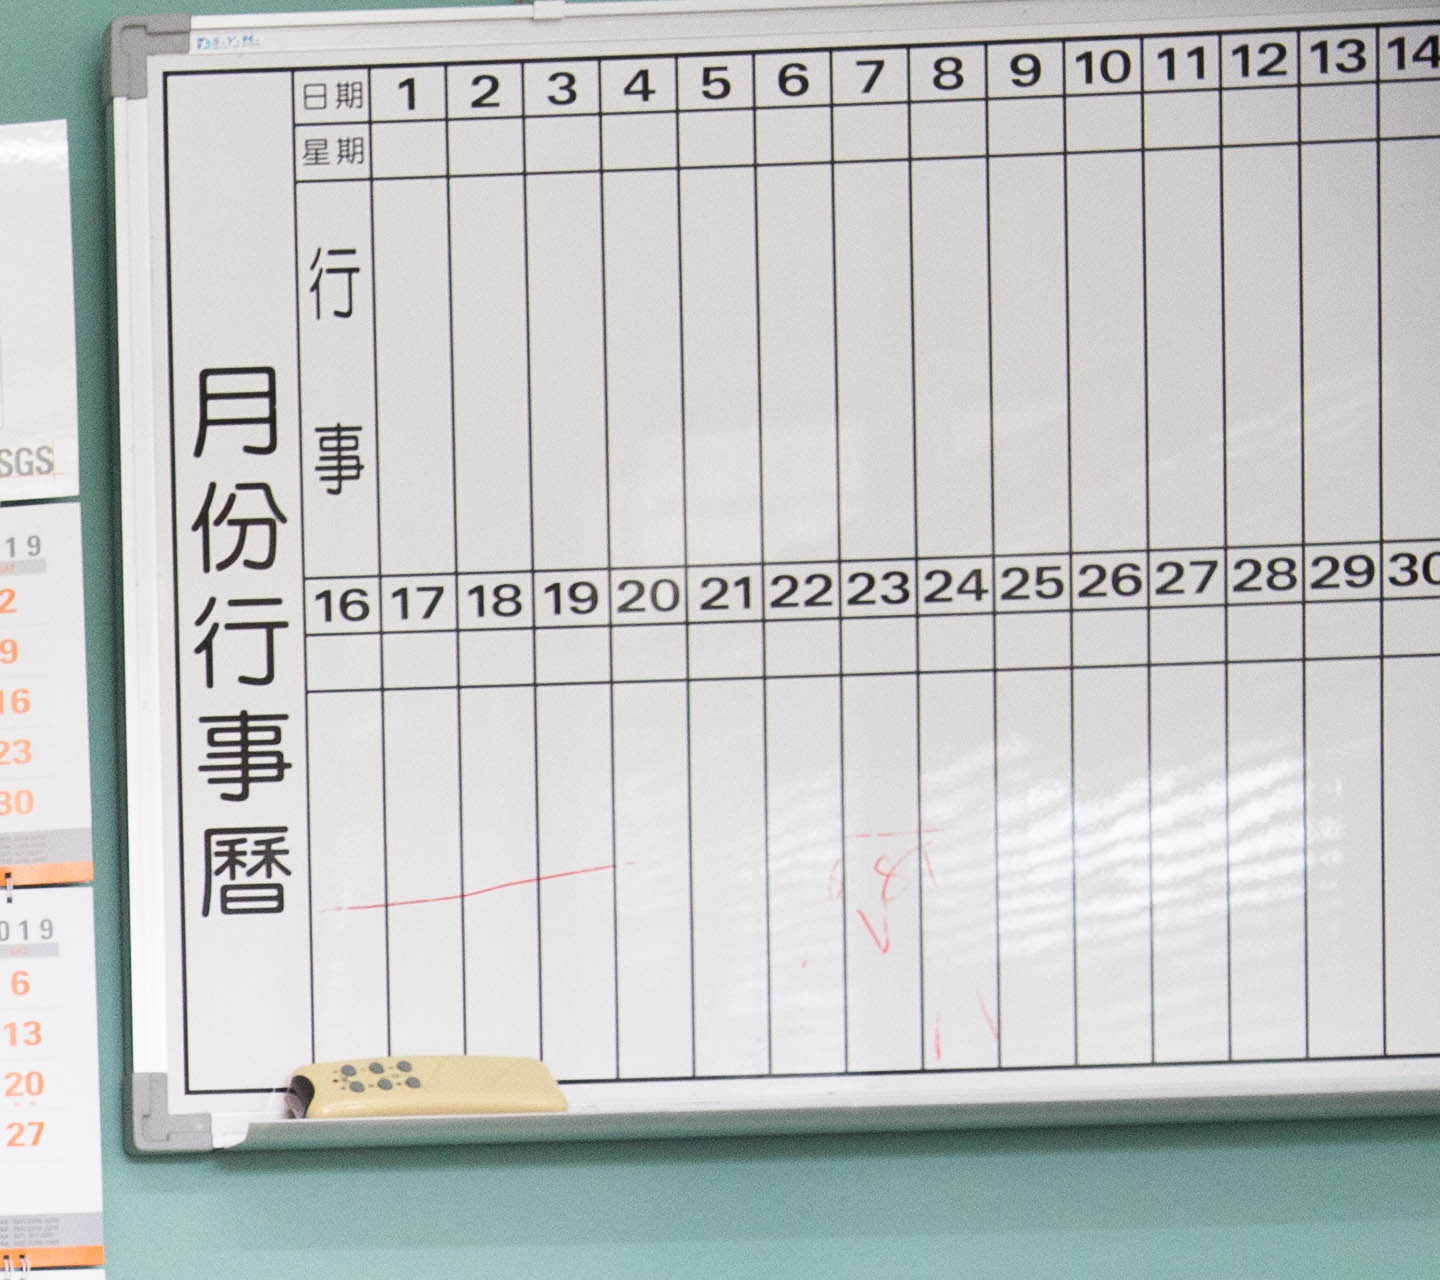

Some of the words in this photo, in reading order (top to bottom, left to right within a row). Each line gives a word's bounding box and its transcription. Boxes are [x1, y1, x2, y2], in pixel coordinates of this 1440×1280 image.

[399, 78, 415, 110] 1
[472, 75, 499, 108] 2
[548, 72, 576, 105] 3
[624, 69, 655, 101] 4
[702, 67, 730, 99] 5
[779, 63, 809, 96] 6
[856, 60, 884, 93] 7
[933, 57, 963, 90] 8
[1011, 54, 1041, 87] 9
[1076, 50, 1131, 84] 10
[1158, 46, 1204, 80] 11
[1232, 43, 1287, 77] 12
[1311, 39, 1366, 73] 13
[1388, 35, 1440, 70] 14
[304, 82, 363, 110] 日期
[303, 137, 364, 165] 星期
[316, 589, 369, 622] 16
[392, 586, 444, 619] 17
[469, 584, 522, 617] 18
[545, 582, 598, 614] 19
[618, 579, 679, 613] 20
[701, 577, 750, 610] 21
[771, 574, 832, 608] 22
[848, 571, 909, 605] 23
[924, 569, 988, 603] 24
[1001, 566, 1063, 600] 25
[1079, 563, 1142, 597] 26
[1156, 561, 1218, 594] 27
[1233, 558, 1297, 592] 28
[1311, 555, 1374, 589] 29
[1389, 552, 1440, 586] 30
[0, 640, 18, 664] 9
[192, 367, 291, 917] 月份行事曆
[5, 1072, 43, 1096] 20
